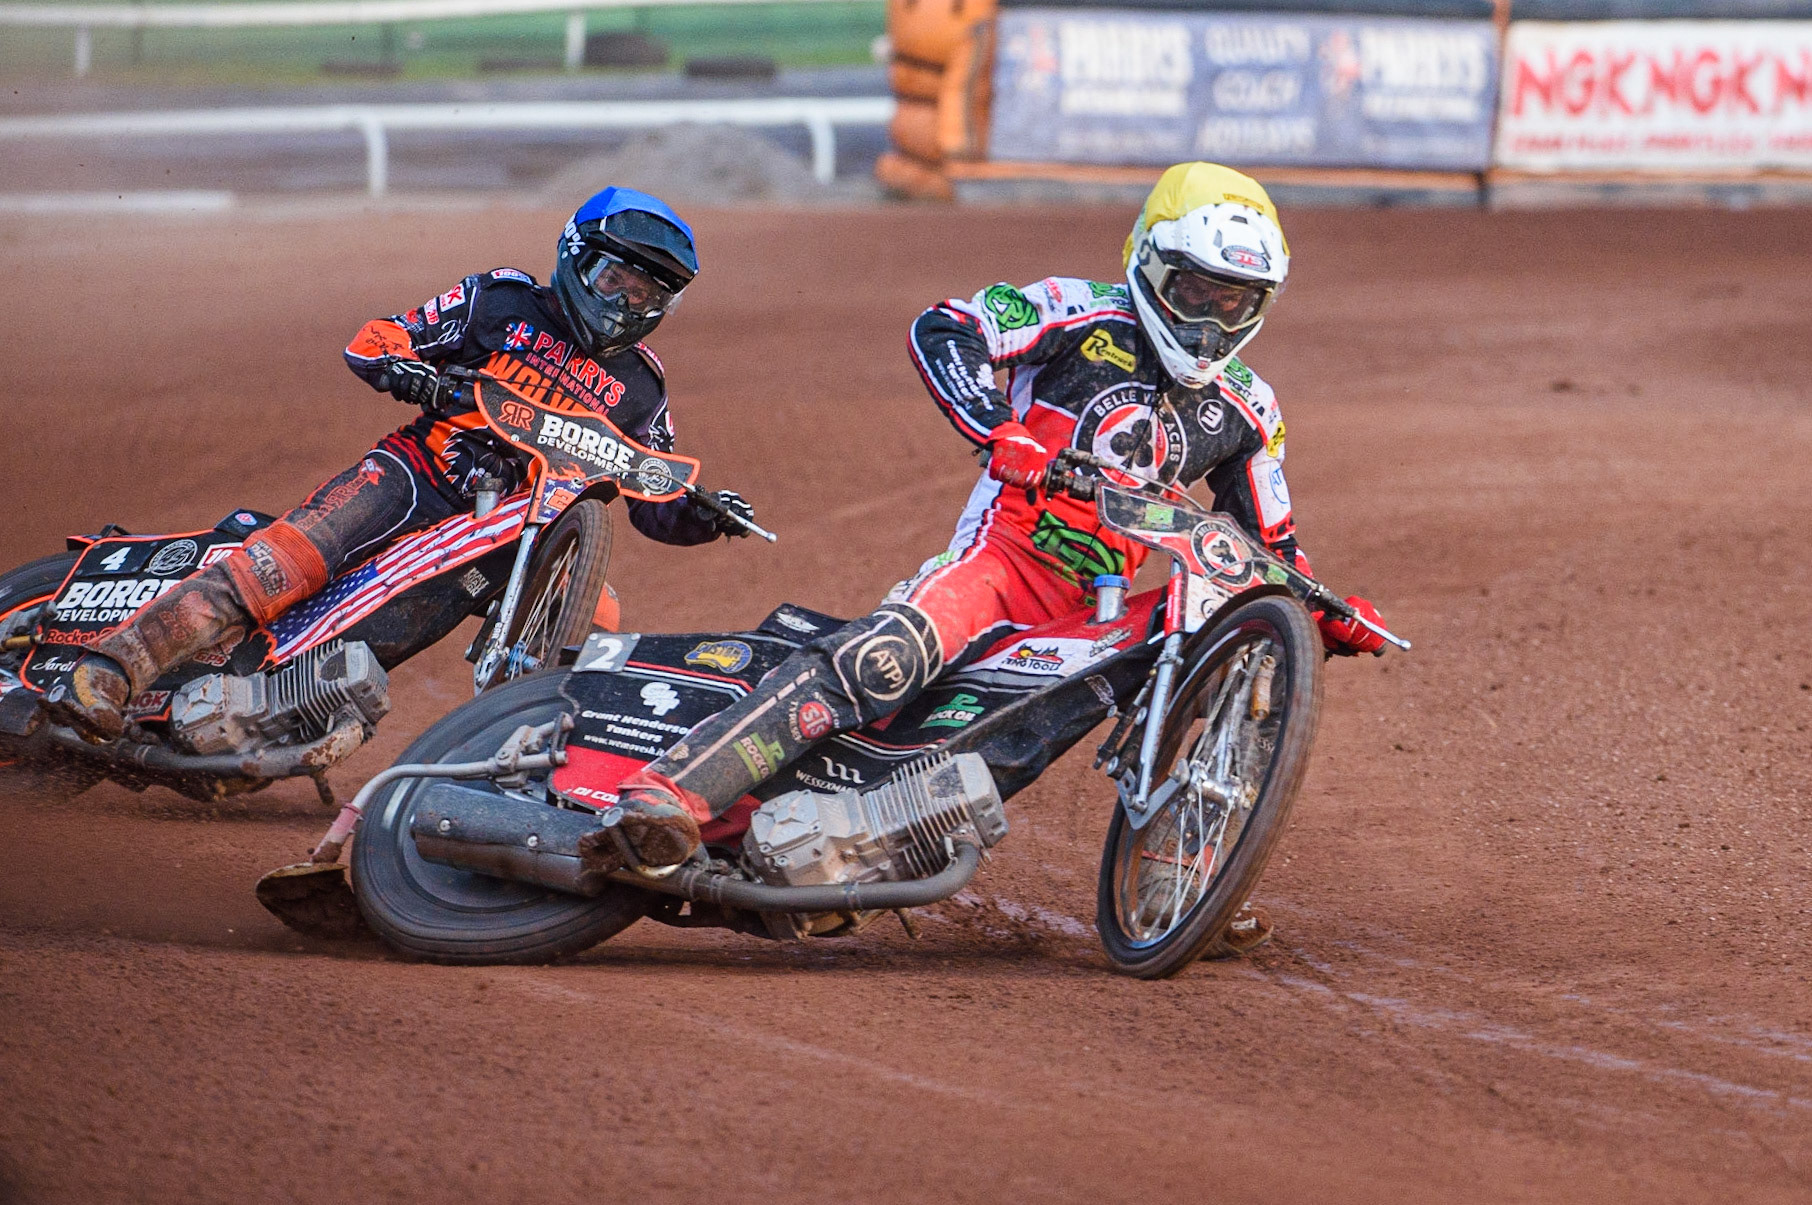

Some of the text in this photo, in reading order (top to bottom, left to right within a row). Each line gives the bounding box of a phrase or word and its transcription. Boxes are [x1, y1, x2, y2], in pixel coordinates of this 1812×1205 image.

[532, 331, 626, 408] PARRYS
[539, 413, 635, 470] BORGE
[1094, 390, 1137, 418] BELLE
[1165, 422, 1181, 462] ACES
[536, 435, 629, 480] DEVELOPMENT
[99, 546, 131, 571] 4
[54, 608, 136, 623] DEVELOPM
[584, 637, 624, 670] 2
[581, 710, 693, 735] Grant Henderso
[606, 723, 664, 743] Tankers
